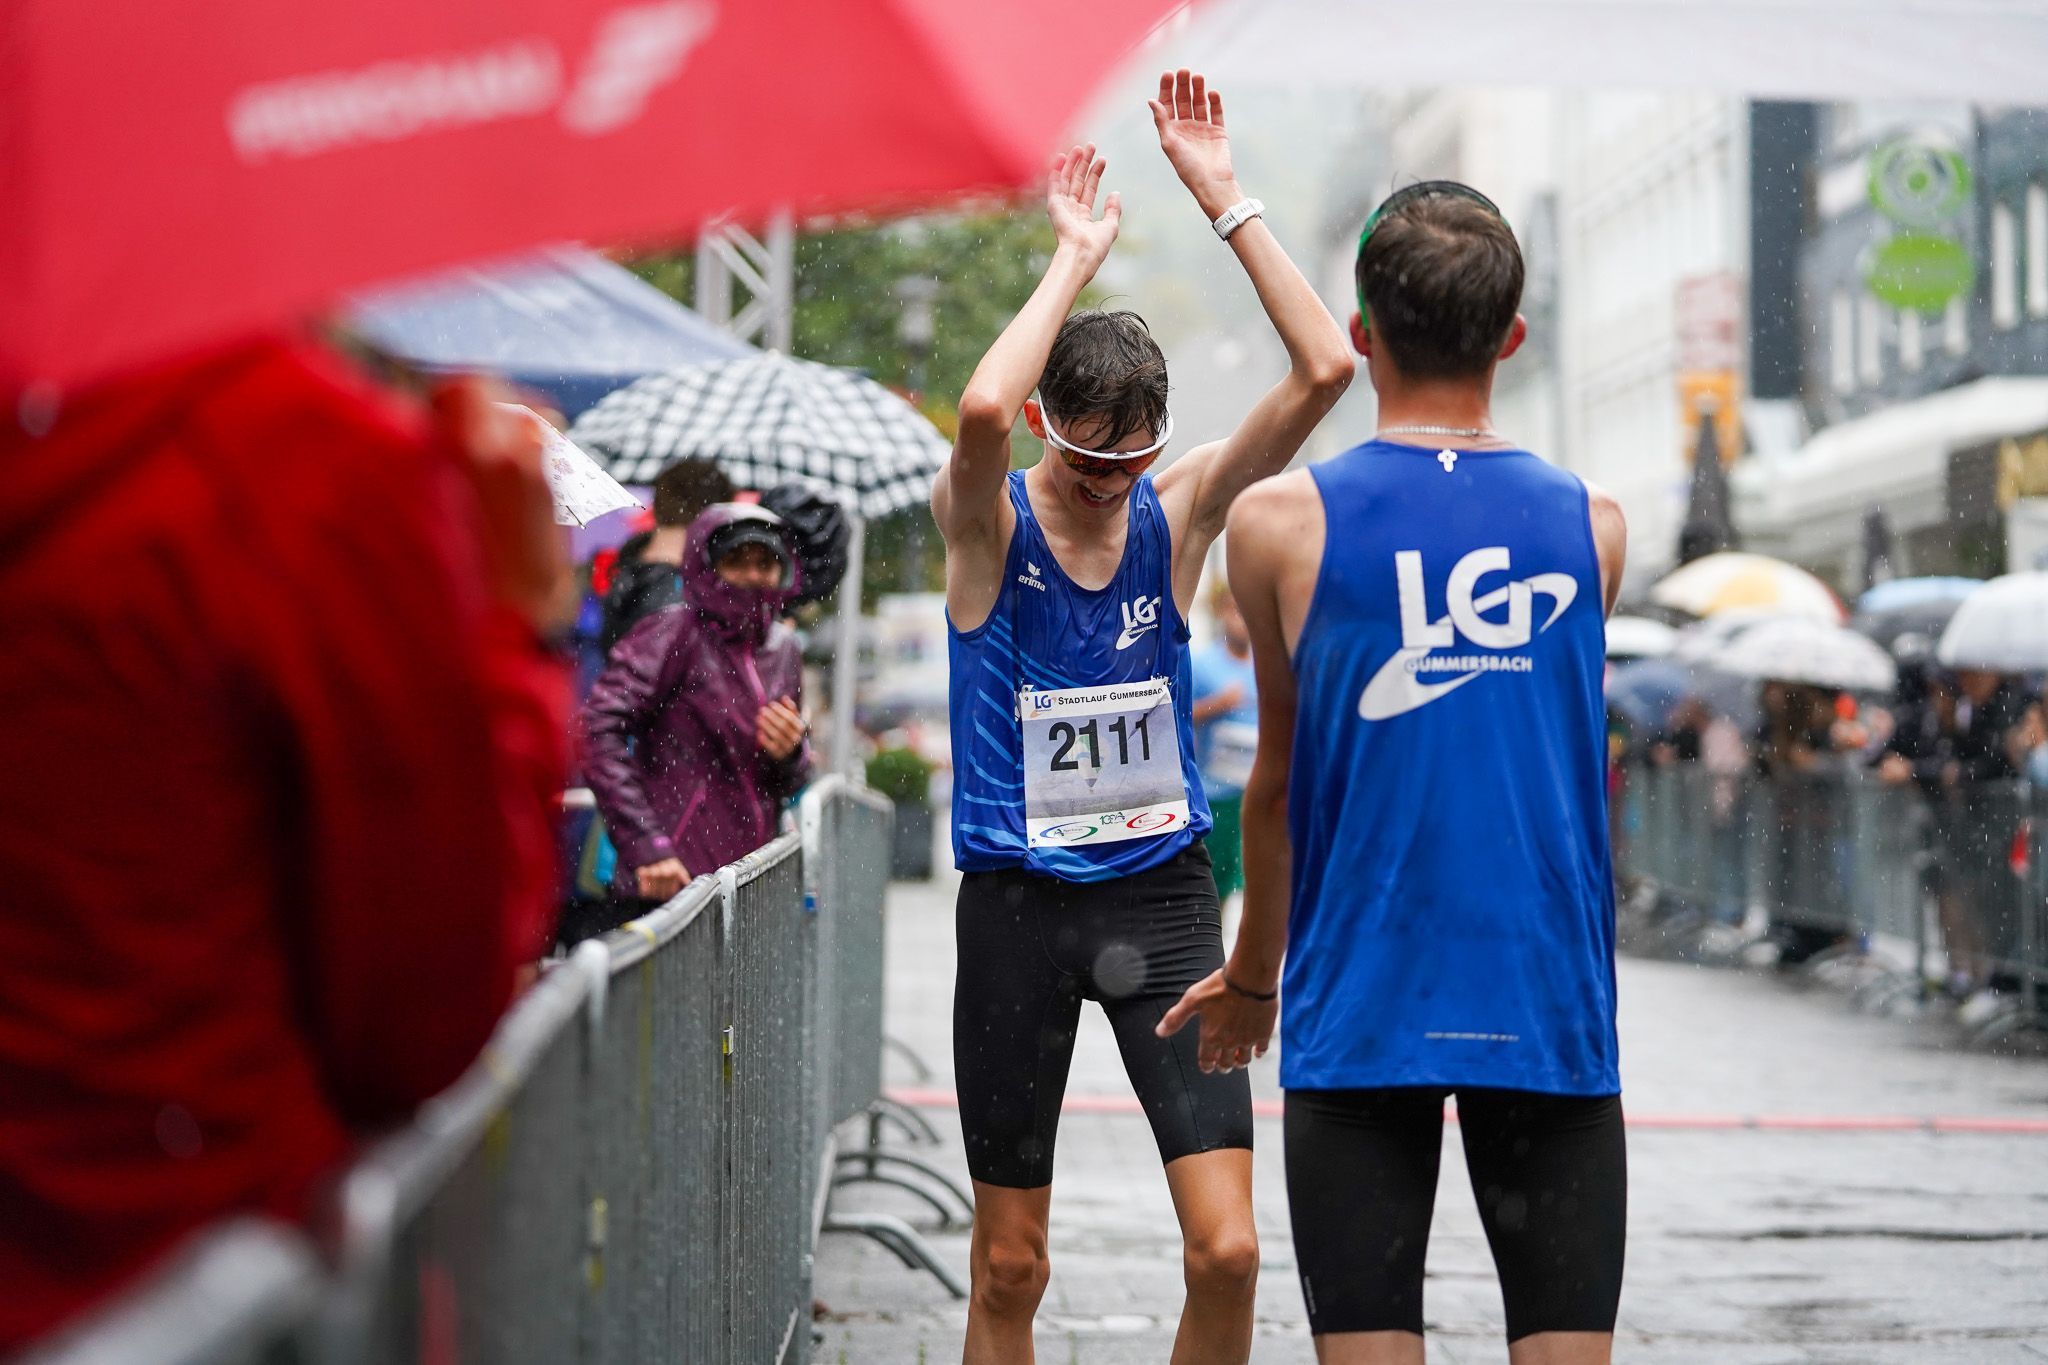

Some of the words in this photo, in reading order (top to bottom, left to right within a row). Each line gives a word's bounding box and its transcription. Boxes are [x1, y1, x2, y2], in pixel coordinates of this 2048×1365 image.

[1018, 574, 1046, 592] erima
[1395, 546, 1533, 649] LG
[1121, 594, 1157, 629] LG
[1404, 655, 1533, 673] GUMMERSBACH
[1034, 694, 1052, 709] LG
[1058, 694, 1107, 705] STADTLAUF
[1109, 687, 1164, 701] GUMMERSBAC
[1048, 713, 1150, 772] 2111
